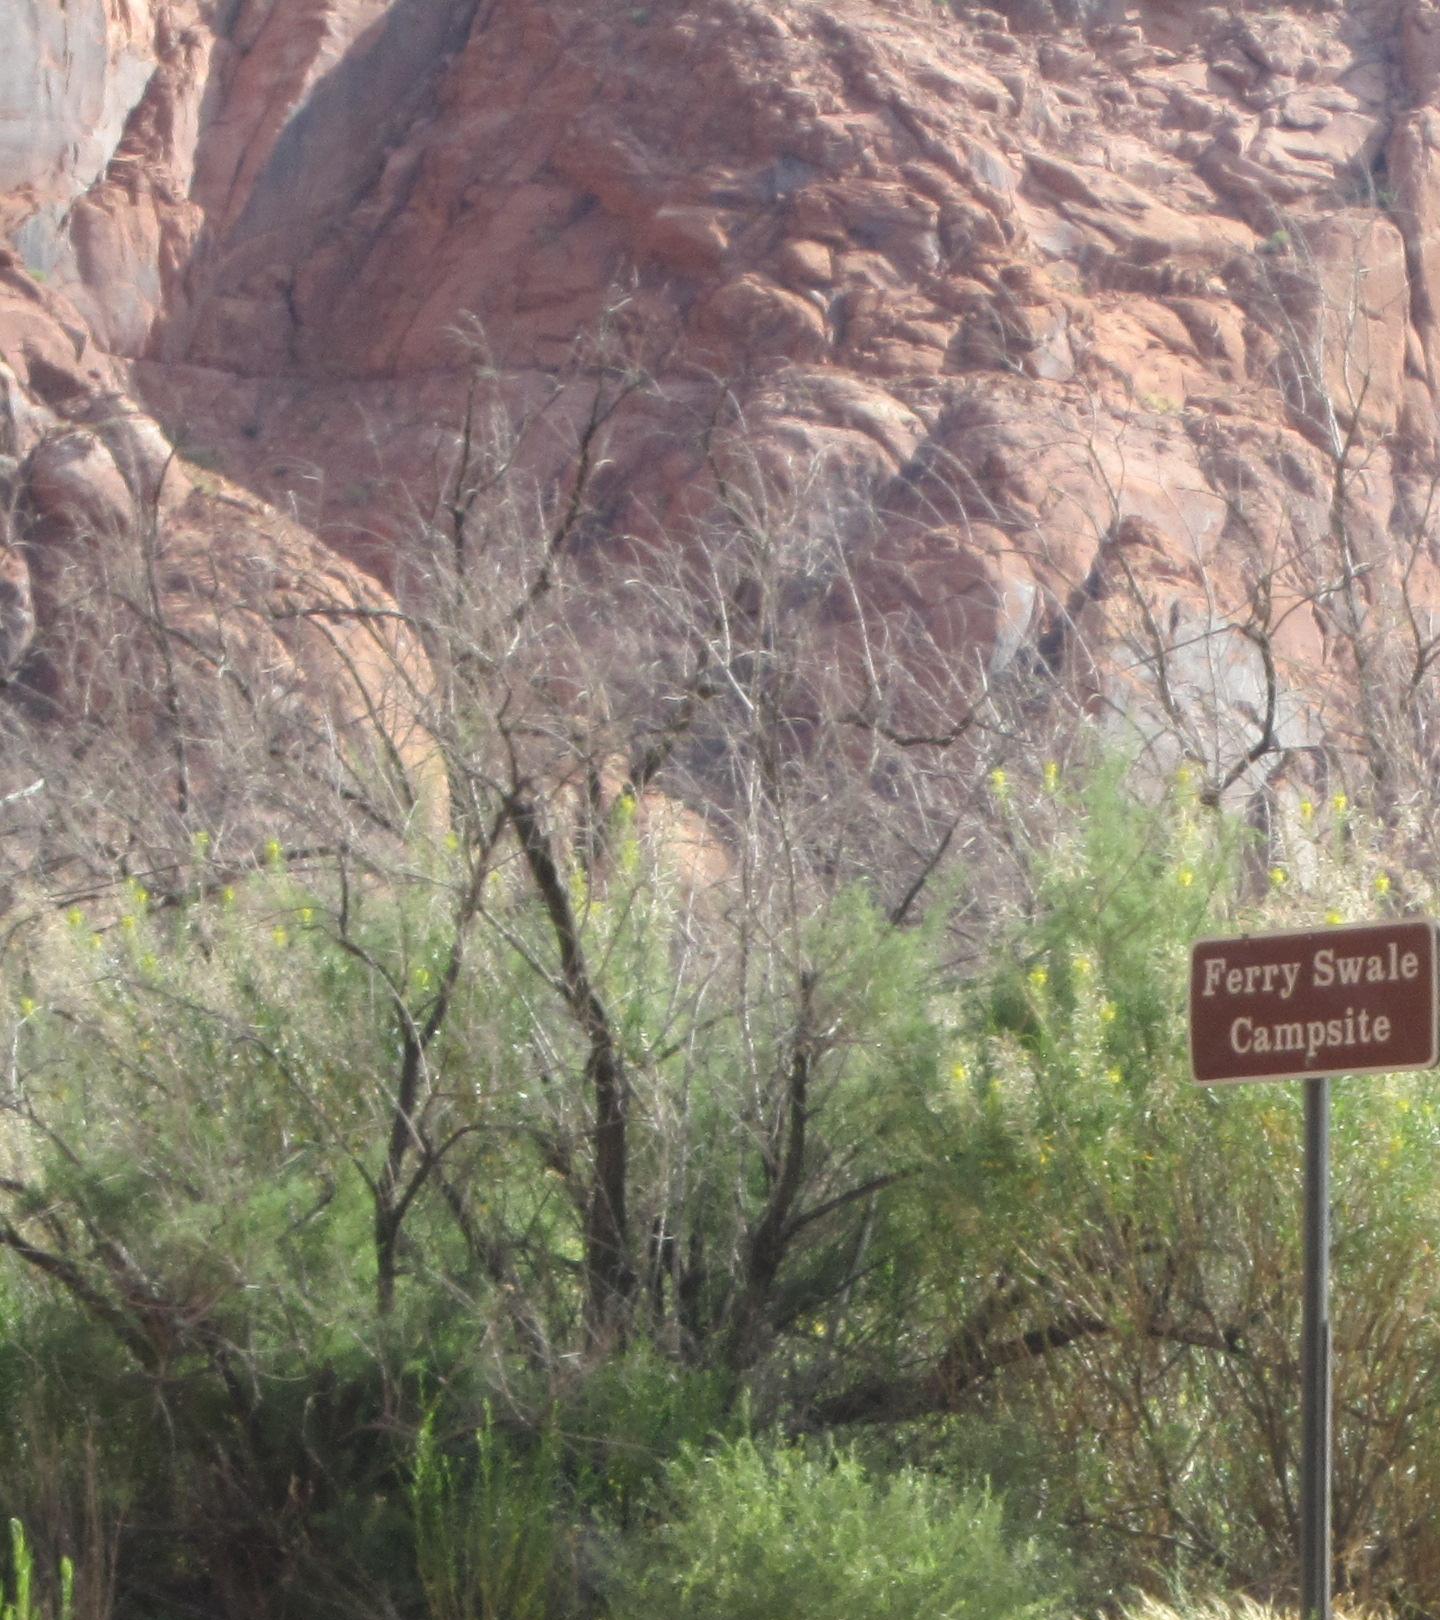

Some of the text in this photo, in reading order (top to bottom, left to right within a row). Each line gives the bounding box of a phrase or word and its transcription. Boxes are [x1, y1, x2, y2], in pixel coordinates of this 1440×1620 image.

[1202, 942, 1419, 999] Ferry Swale
[1230, 1007, 1391, 1057] Campsite
